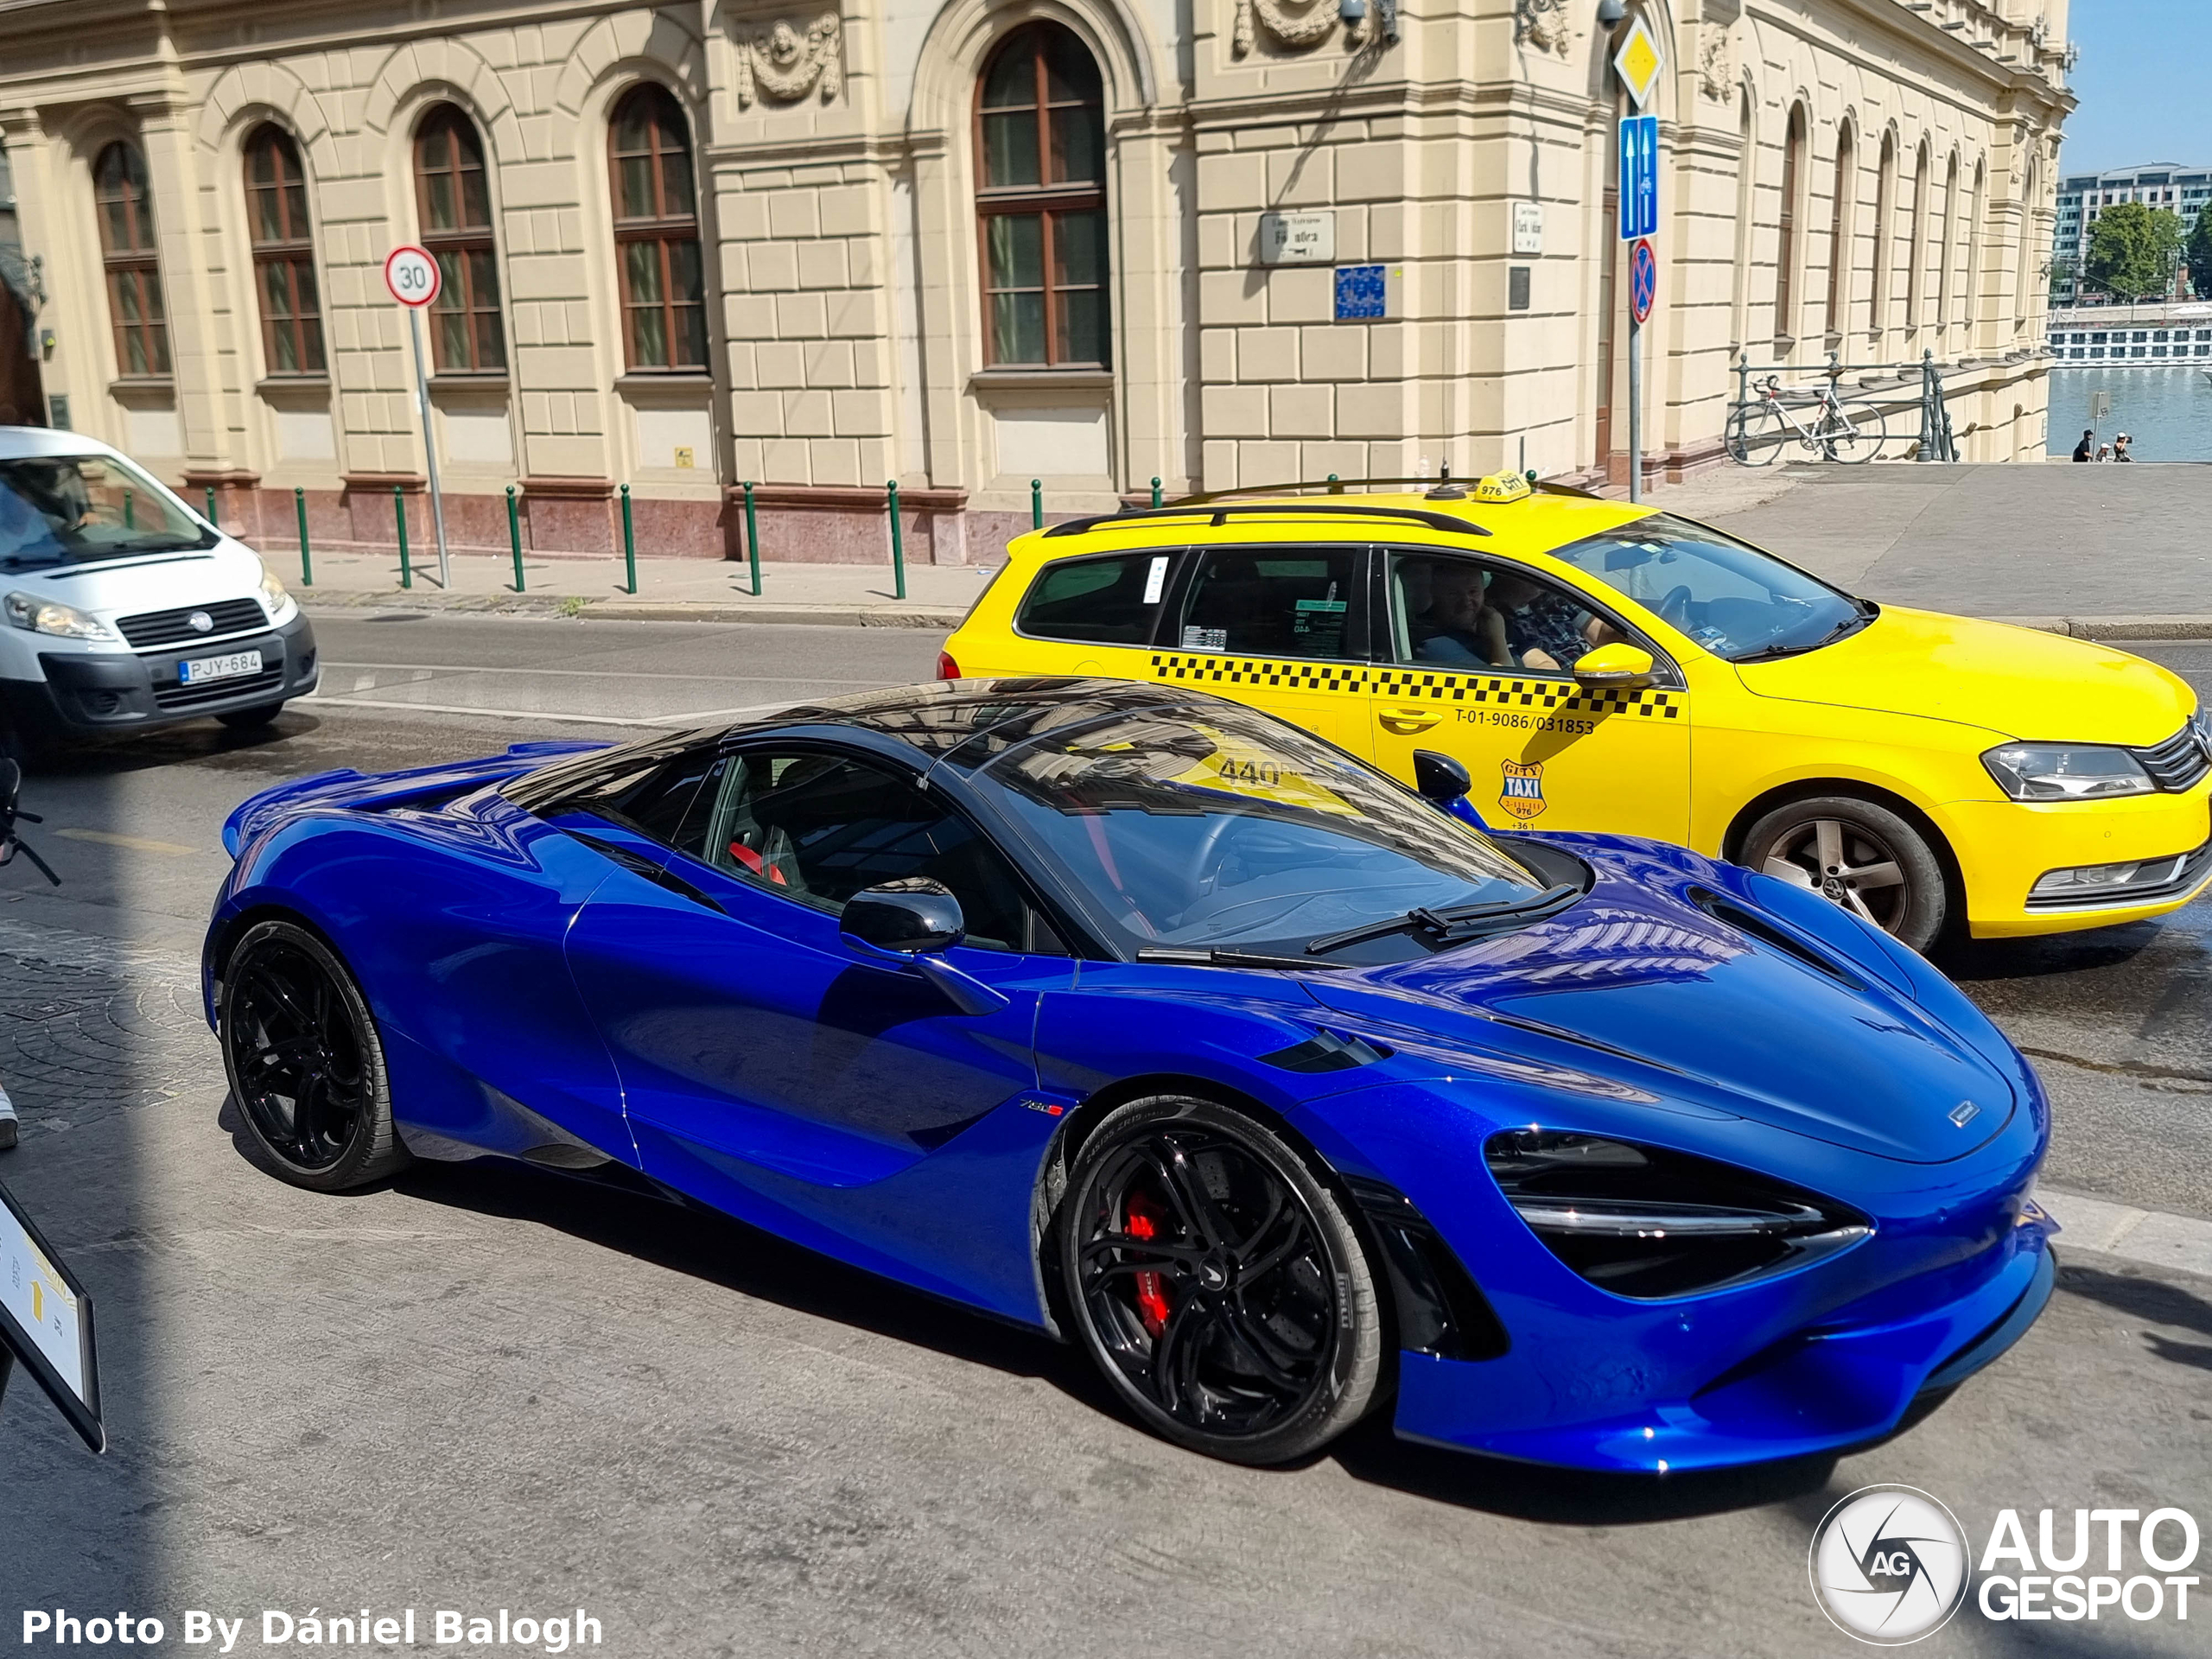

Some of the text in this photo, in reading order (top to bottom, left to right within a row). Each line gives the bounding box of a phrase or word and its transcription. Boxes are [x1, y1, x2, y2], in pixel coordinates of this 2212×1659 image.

[400, 266, 426, 289] 30
[1481, 486, 1502, 496] 976
[191, 654, 259, 677] PJY-684
[1455, 709, 1595, 735] T-01-9086/031853
[1218, 757, 1280, 789] 440
[1505, 764, 1538, 777] CITY
[1506, 778, 1539, 798] TAXI
[1516, 807, 1532, 816] 976
